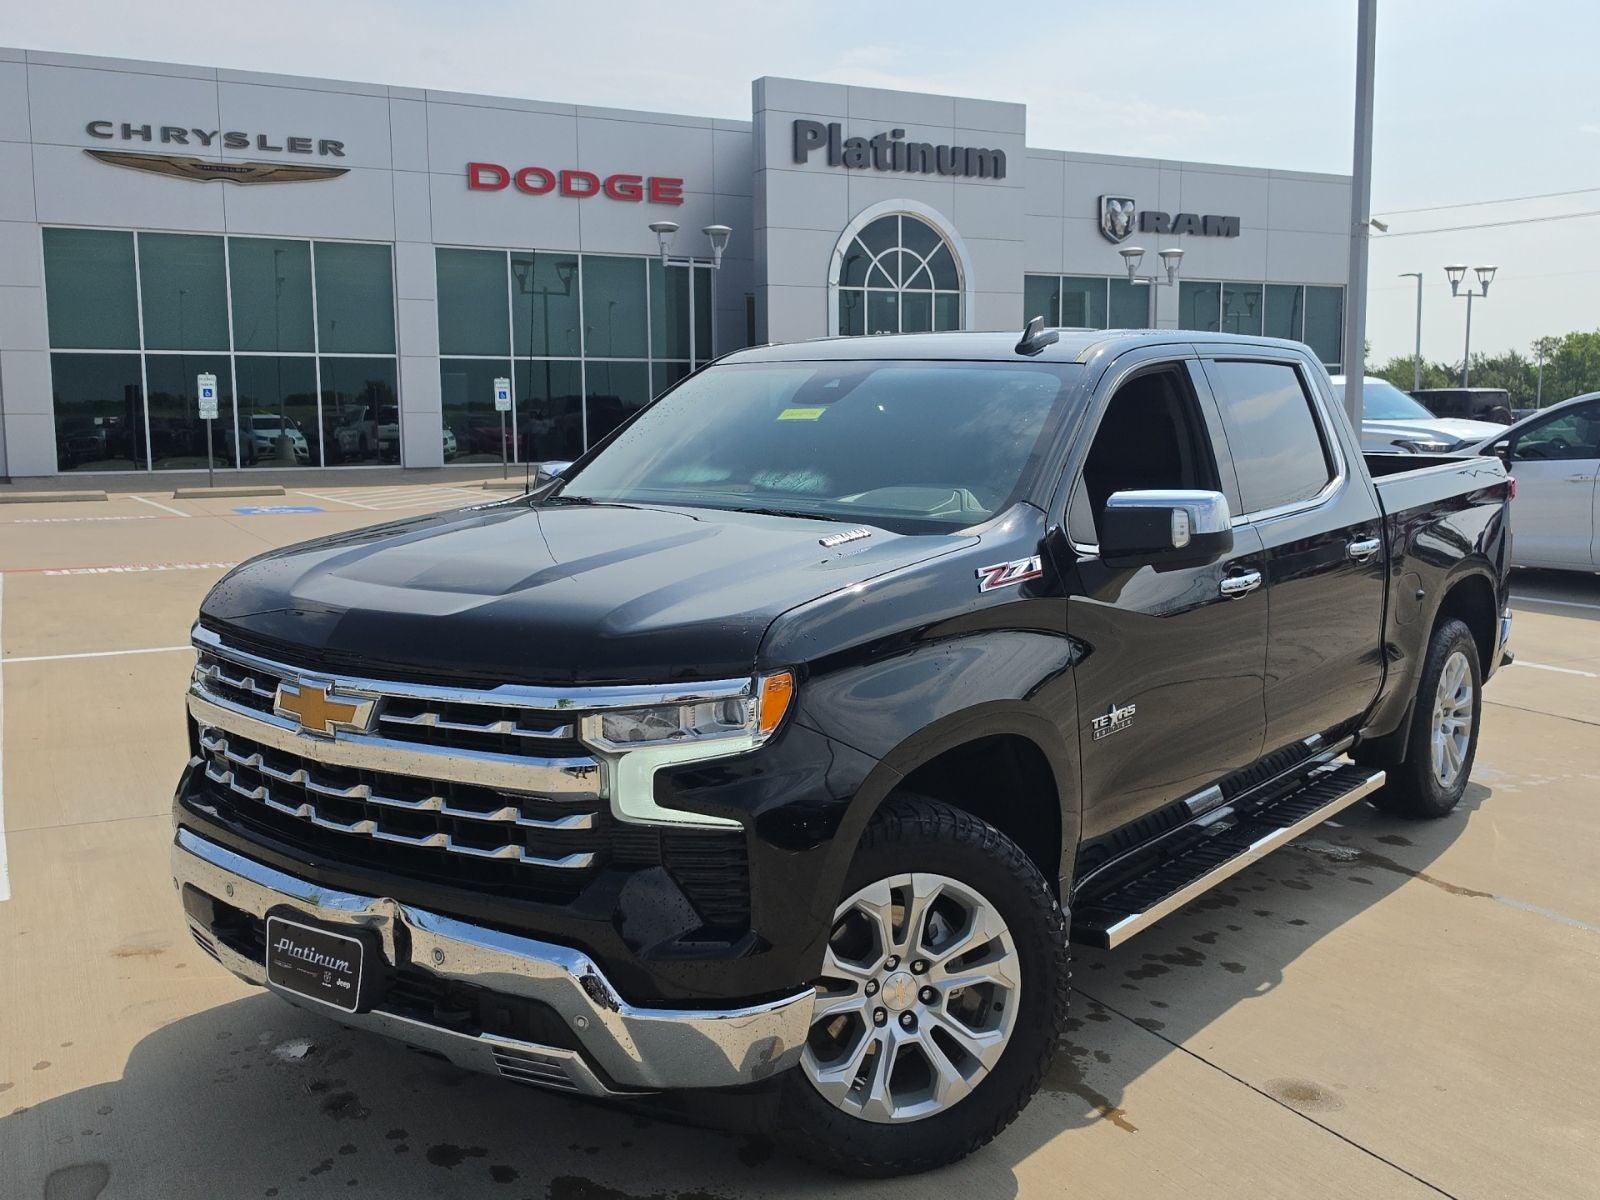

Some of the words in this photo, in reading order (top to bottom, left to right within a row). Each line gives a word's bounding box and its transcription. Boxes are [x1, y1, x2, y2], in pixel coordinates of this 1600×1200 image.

[86, 120, 346, 157] CHRYSLER
[793, 119, 1006, 179] Platinum
[467, 162, 684, 205] DODGE
[1140, 211, 1240, 238] RAM
[975, 555, 1043, 593] Z71
[1091, 703, 1136, 730] TEXAS
[274, 938, 352, 974] Platinum
